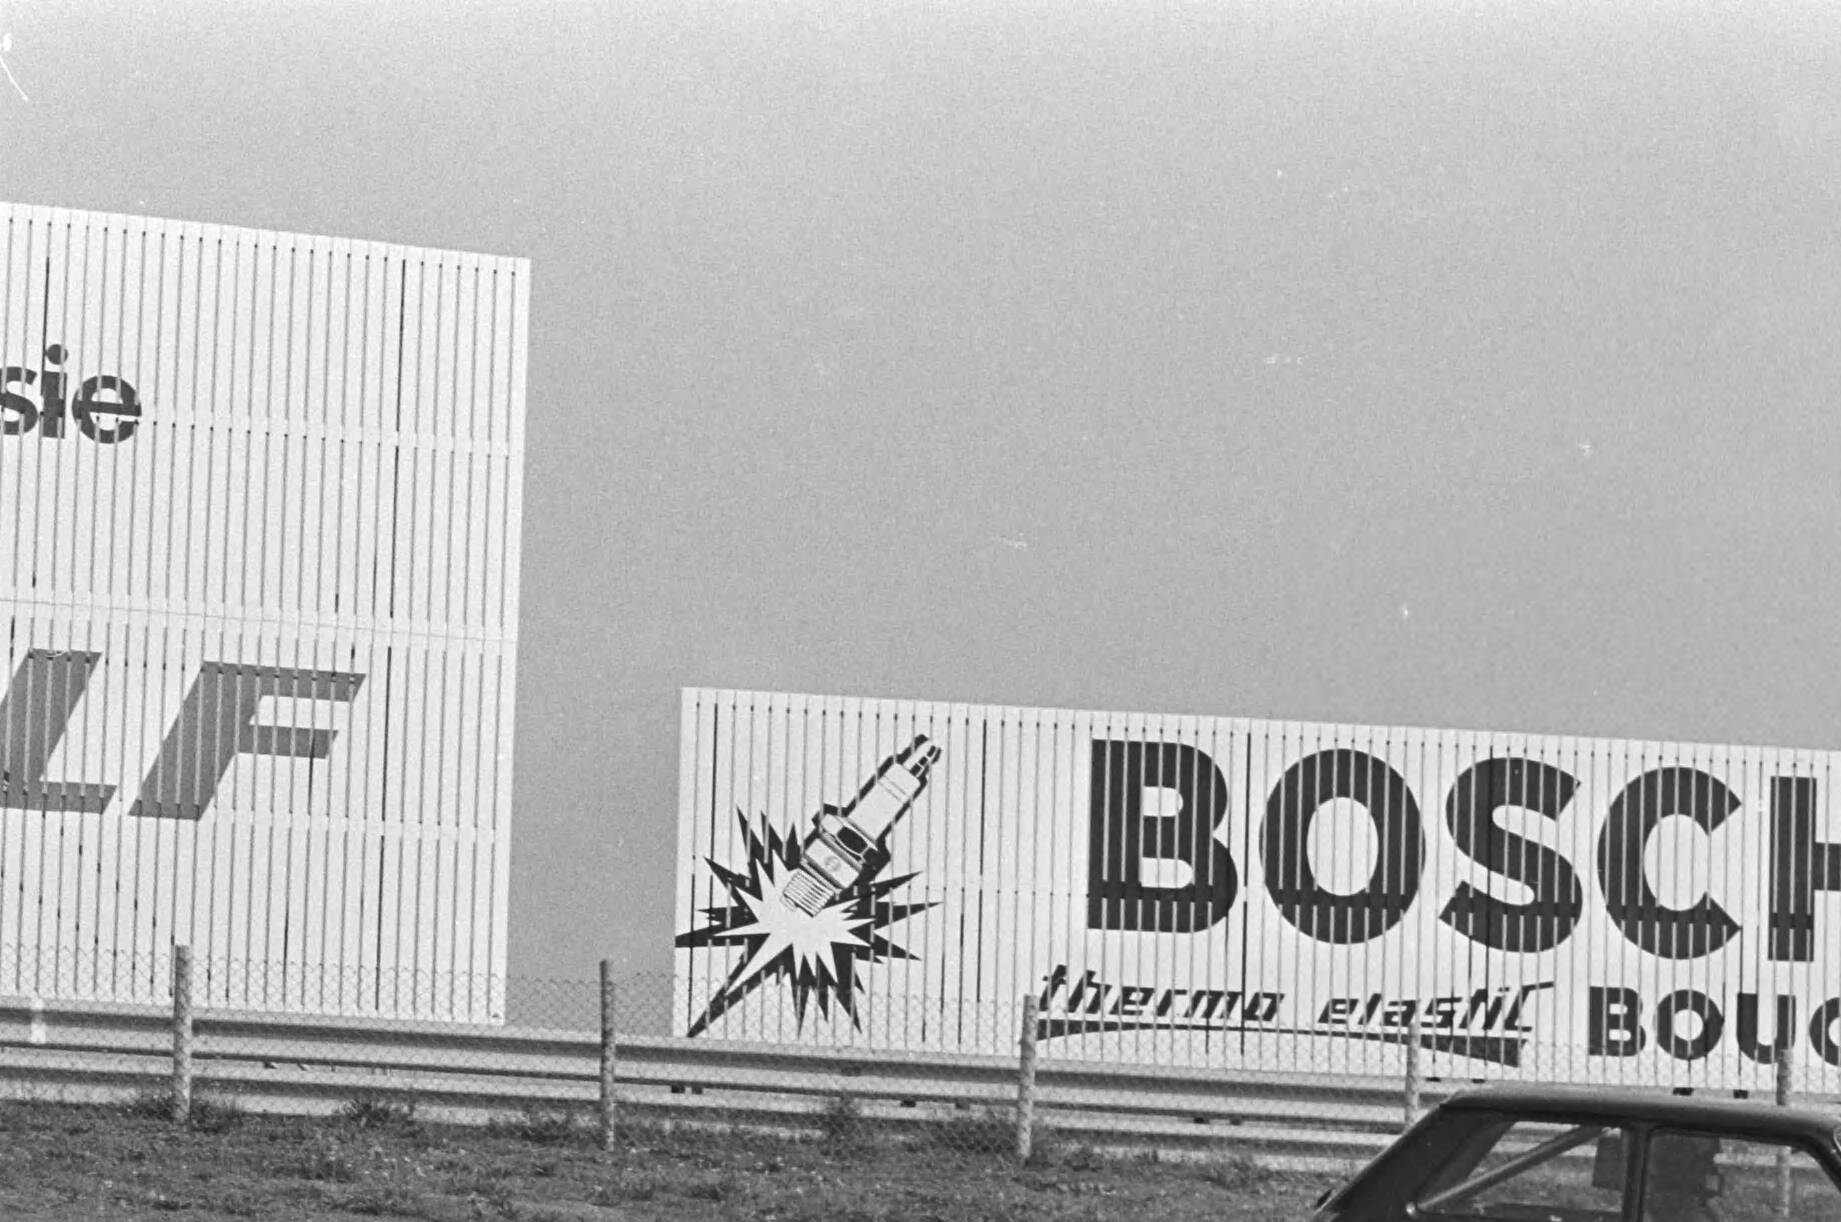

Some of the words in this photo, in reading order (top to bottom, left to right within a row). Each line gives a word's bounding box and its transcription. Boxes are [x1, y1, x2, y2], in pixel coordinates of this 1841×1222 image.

[0, 344, 142, 444] sie
[1040, 964, 1285, 1023] thermo
[1317, 981, 1555, 1033] elastic
